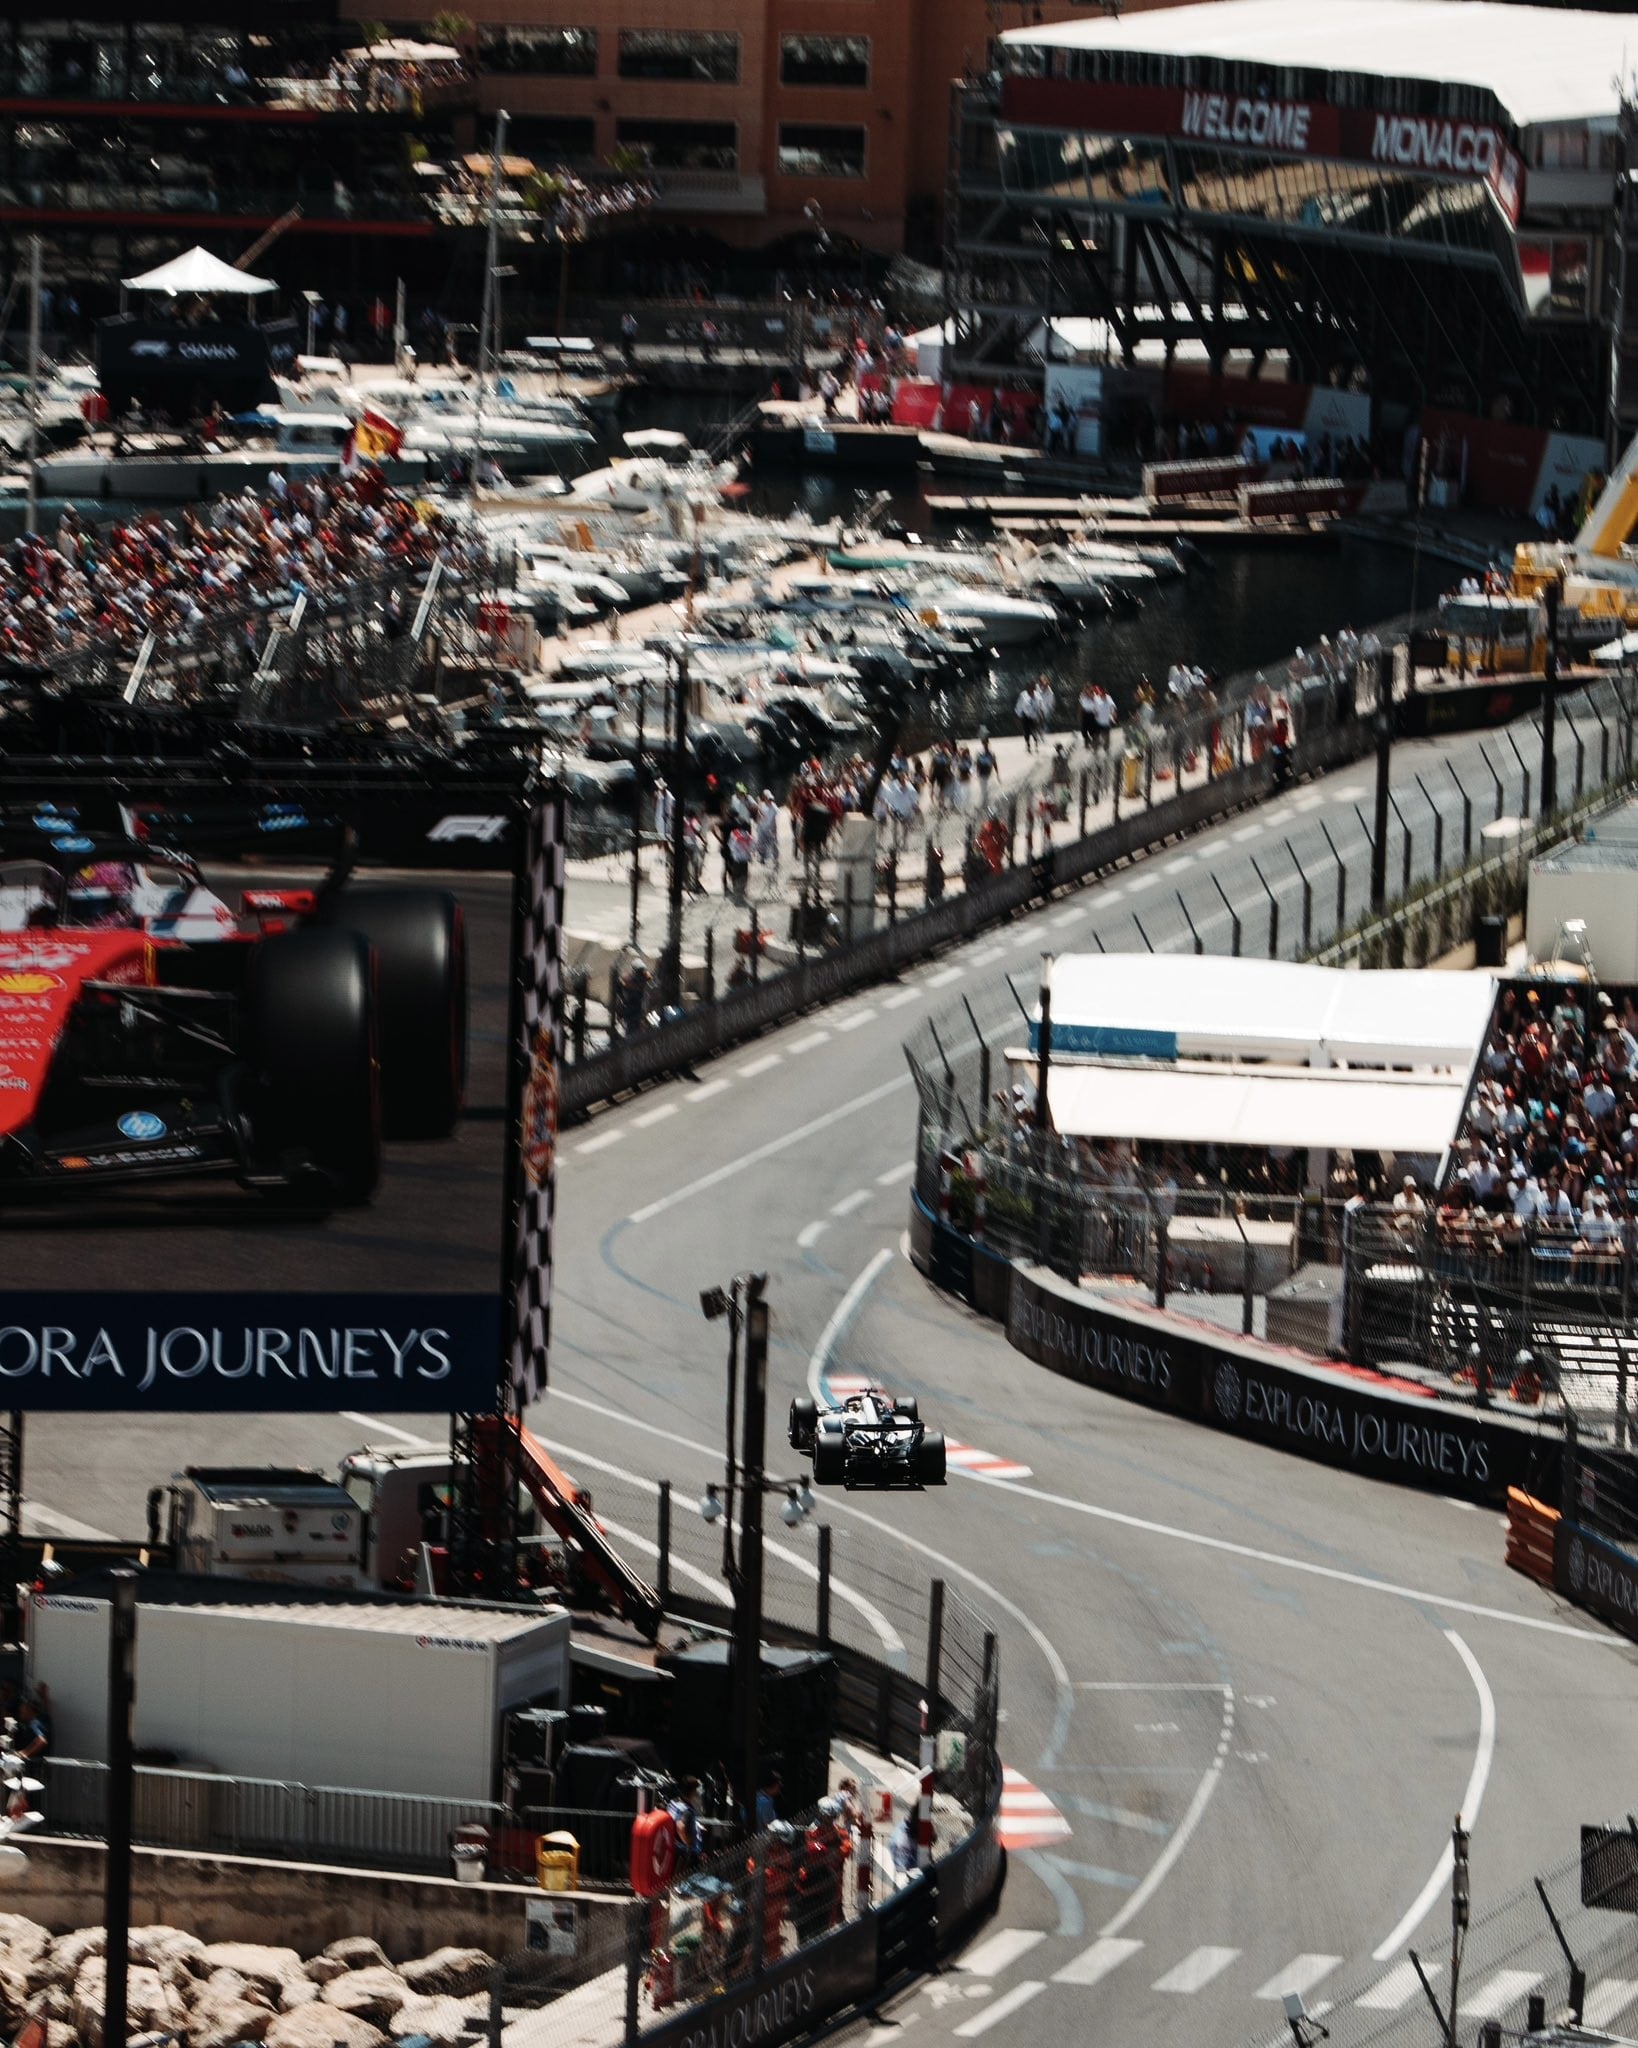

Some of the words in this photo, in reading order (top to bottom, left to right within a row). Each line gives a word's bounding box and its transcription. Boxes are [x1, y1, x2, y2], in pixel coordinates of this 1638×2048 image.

[1181, 91, 1312, 150] WELCOME
[1372, 113, 1496, 174] MONACO
[136, 1327, 451, 1392] JOURNEYS
[1078, 1323, 1173, 1391] JOURNEYS
[1245, 1378, 1348, 1448] EXPLORA
[1352, 1409, 1490, 1482] JOURNEYS
